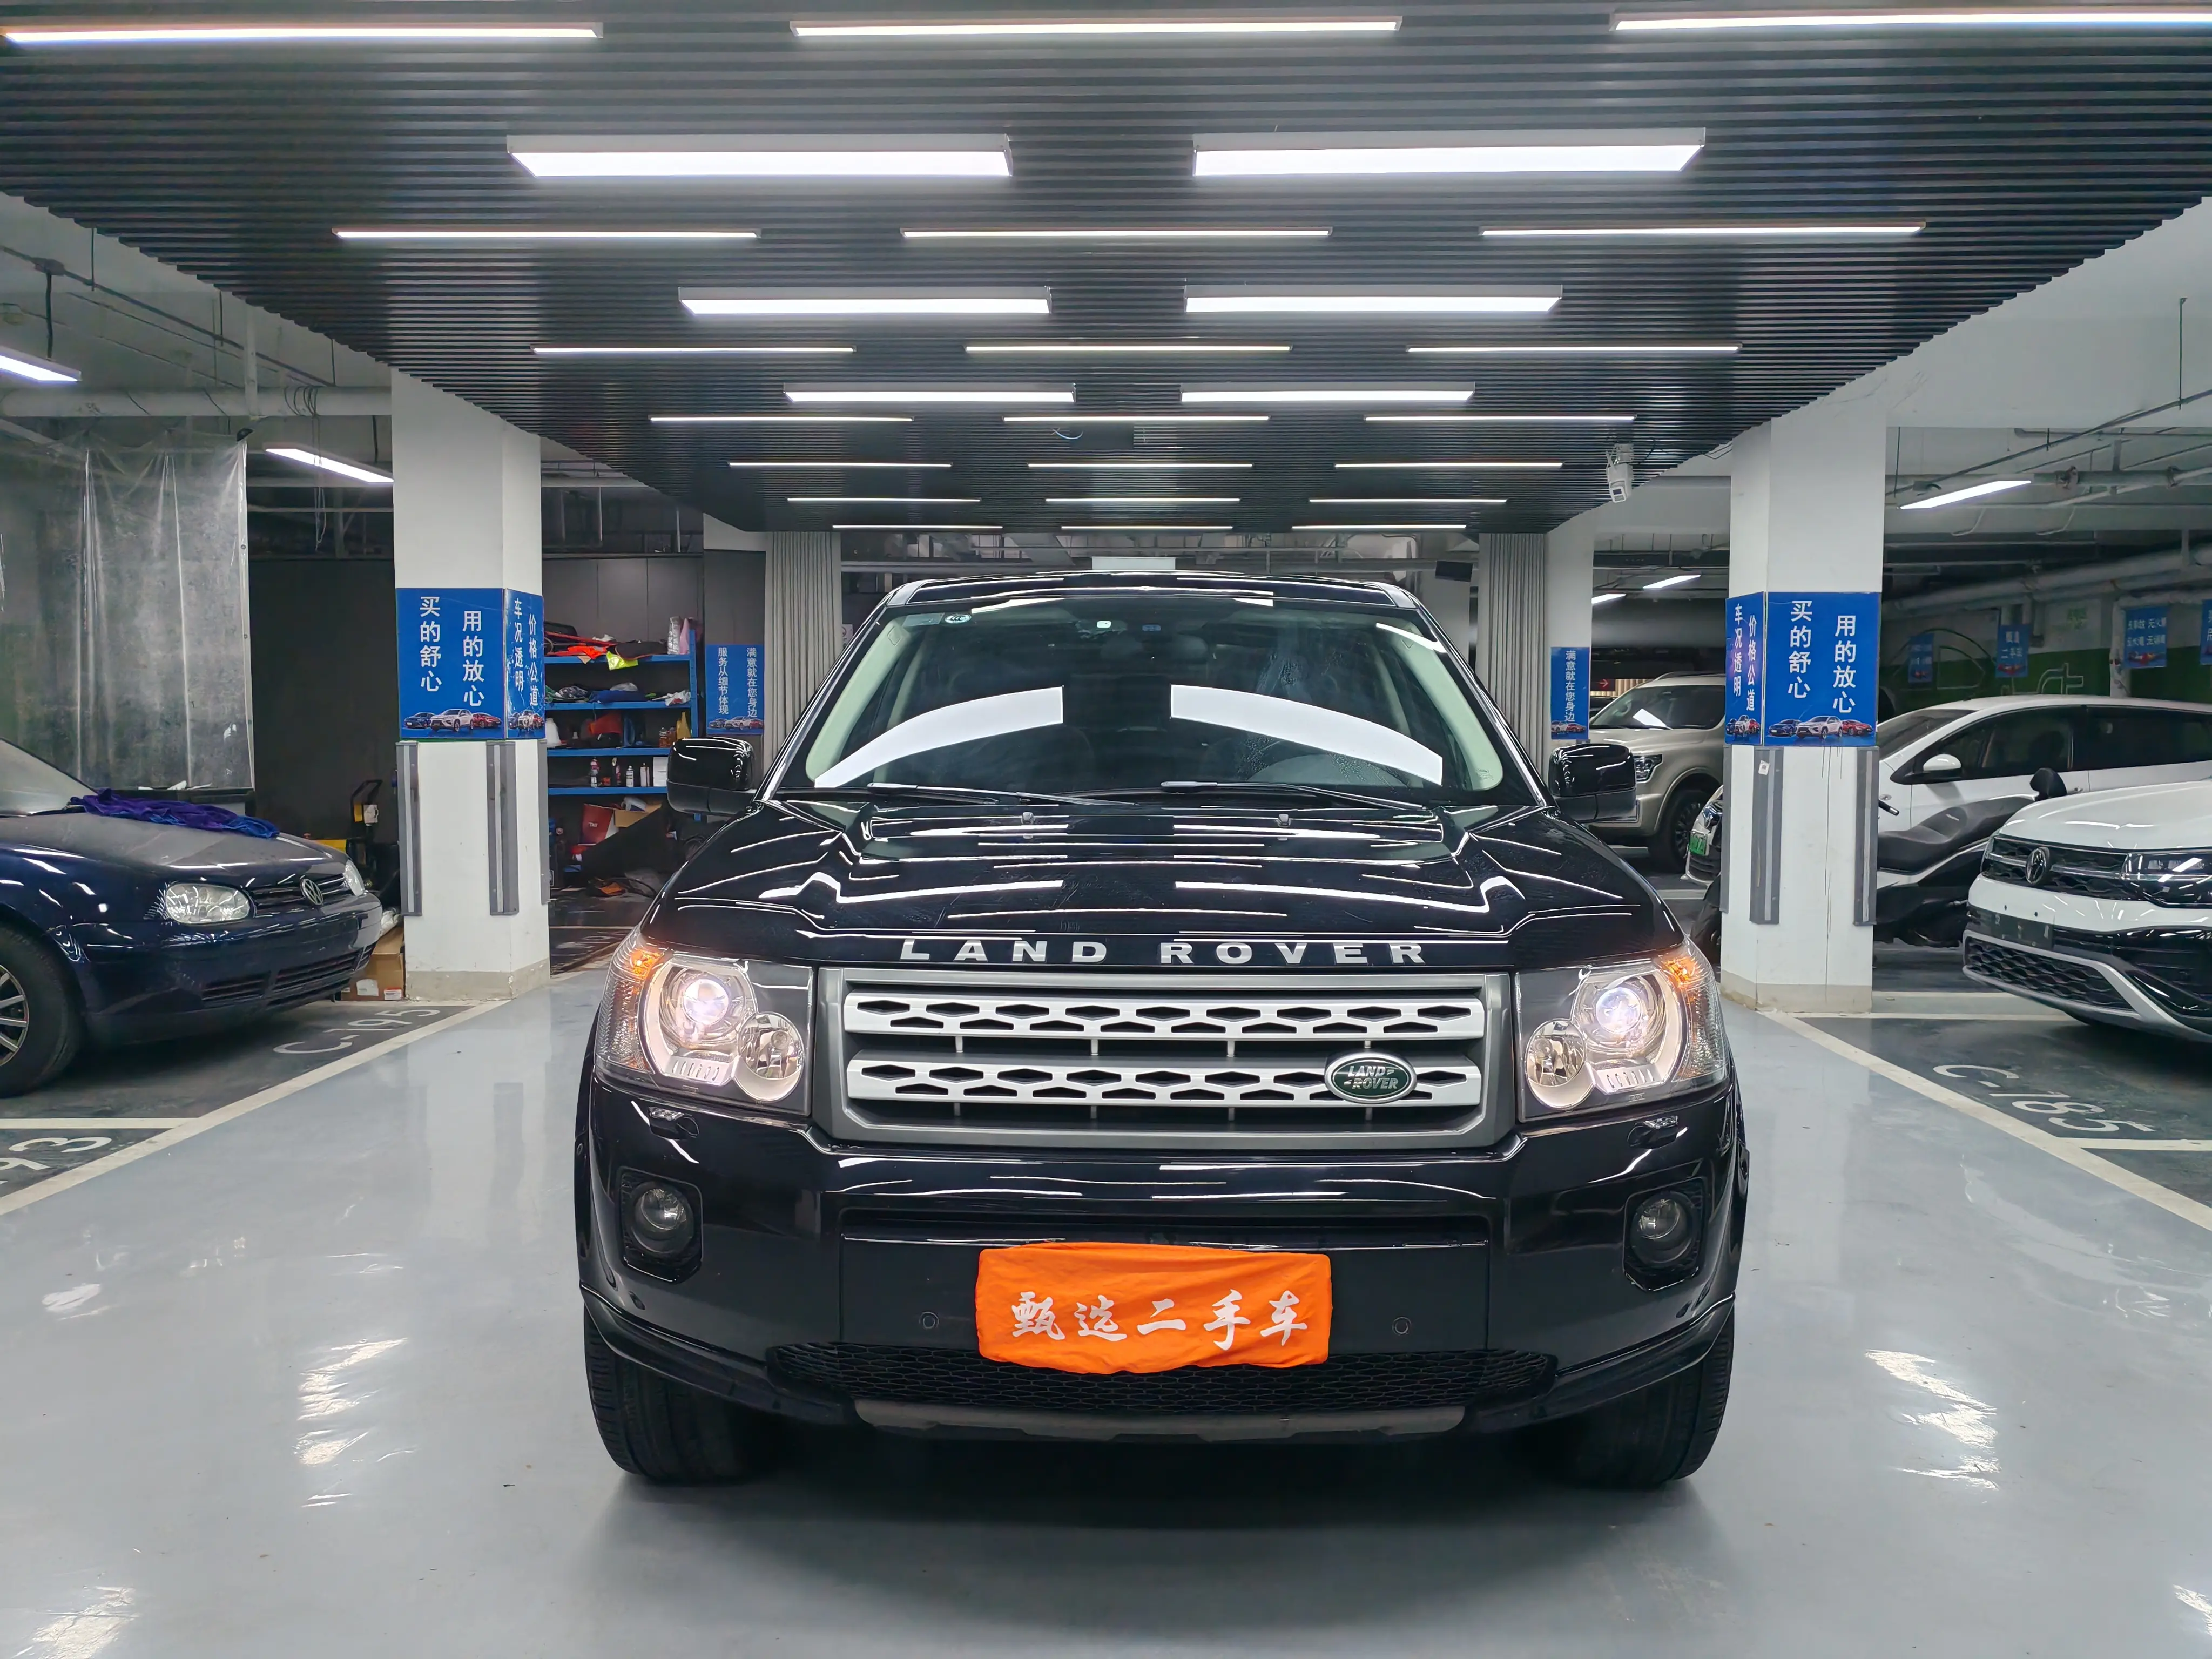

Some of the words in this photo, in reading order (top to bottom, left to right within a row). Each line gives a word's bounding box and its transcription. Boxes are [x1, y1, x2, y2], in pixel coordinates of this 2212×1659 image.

[419, 596, 442, 692] 买的舒心
[462, 610, 485, 707] 用的放心
[514, 598, 524, 691] 车况透明
[528, 613, 539, 706] 价格公道
[1734, 603, 1743, 697] 车况透明
[1746, 615, 1757, 711] 价格公道
[1788, 601, 1812, 699] 买的舒心
[1832, 615, 1857, 714] 用的放心
[718, 647, 729, 716] 服务从细节体现
[746, 647, 758, 718] 满意就在您身边
[1564, 650, 1576, 723] 满意就在您身边
[900, 939, 1107, 963] LAND
[1159, 942, 1425, 965] ROVER
[273, 1009, 440, 1054] C-195
[1347, 1065, 1386, 1077] LAND
[1351, 1077, 1399, 1089] ROVER
[1933, 1064, 2156, 1131] C-185
[1011, 1289, 1308, 1351] 甄选二手车
